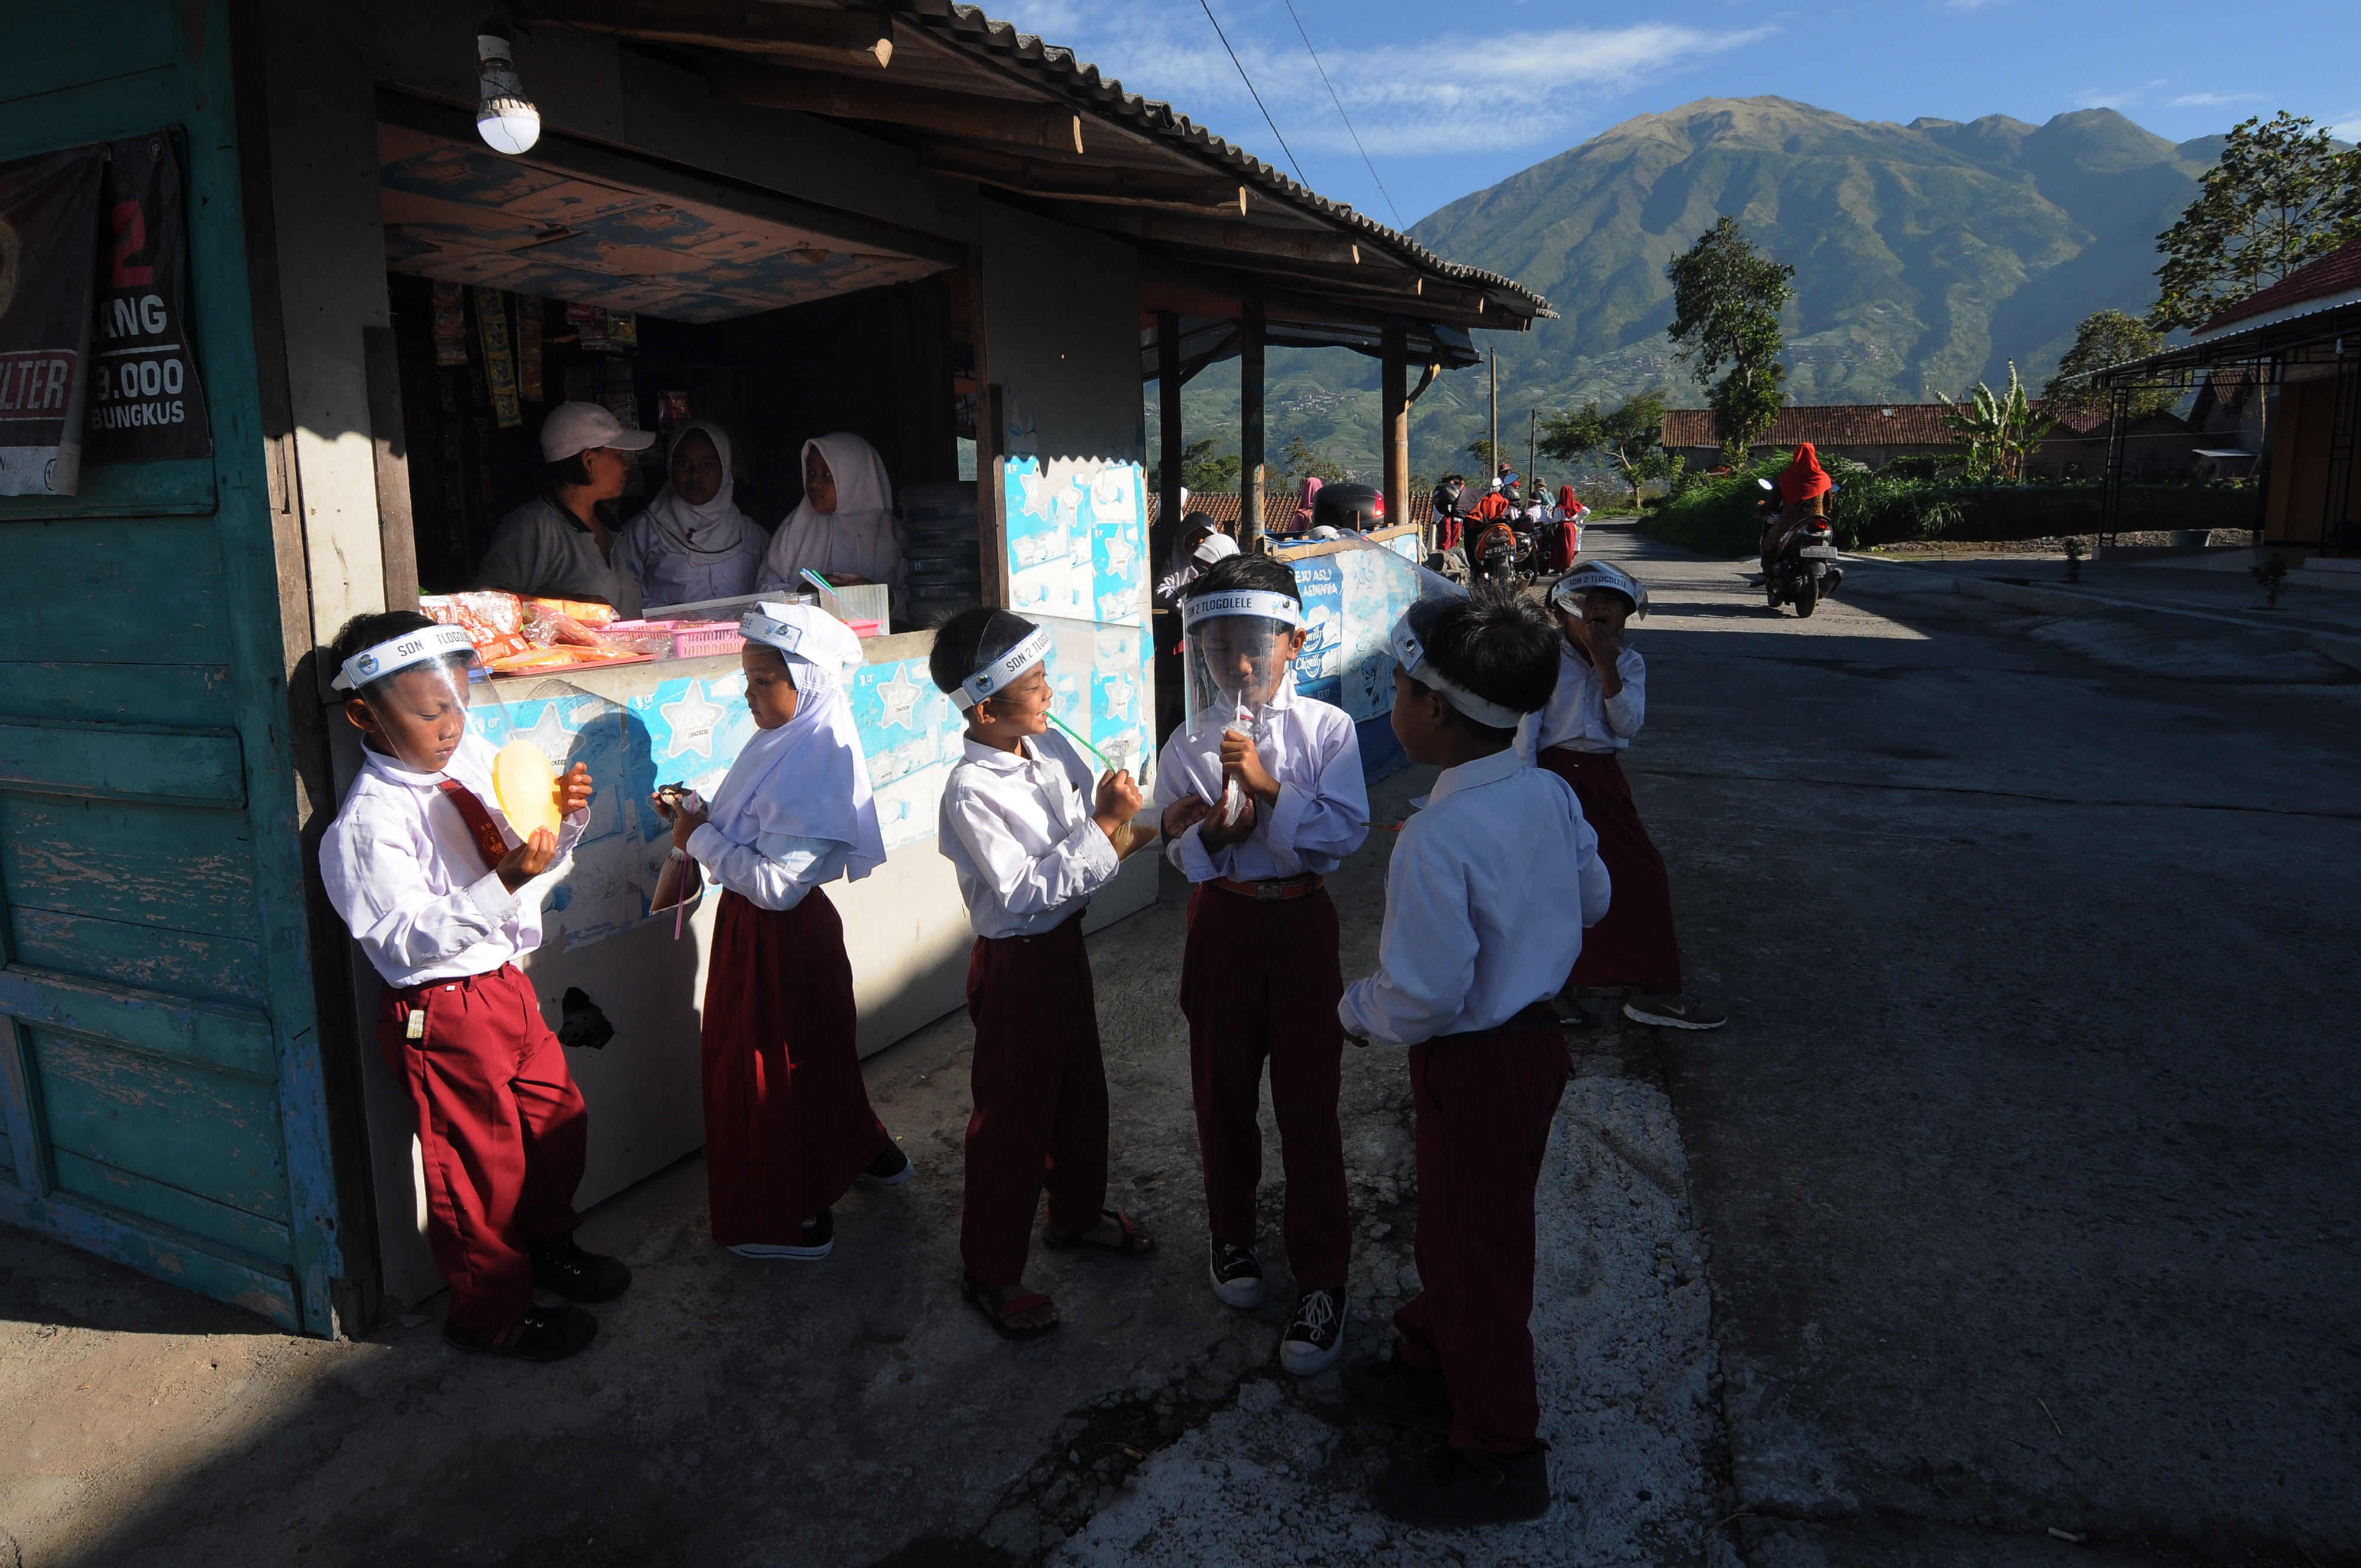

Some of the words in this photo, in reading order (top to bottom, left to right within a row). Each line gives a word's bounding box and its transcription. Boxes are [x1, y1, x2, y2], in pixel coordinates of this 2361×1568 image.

[111, 201, 153, 289] 2
[90, 294, 167, 342] ANG
[91, 400, 185, 430] BUNGKUS
[1295, 569, 1312, 583] EJU
[1569, 577, 1582, 587] SDN
[1591, 575, 1627, 588] TLOGOLELE
[1196, 604, 1200, 614] 2
[1201, 598, 1252, 612] TLOGOLELE
[397, 640, 424, 657] SDN
[1006, 653, 1027, 672] SDN
[1025, 648, 1033, 658] 2
[688, 729, 709, 738] CRACKERS
